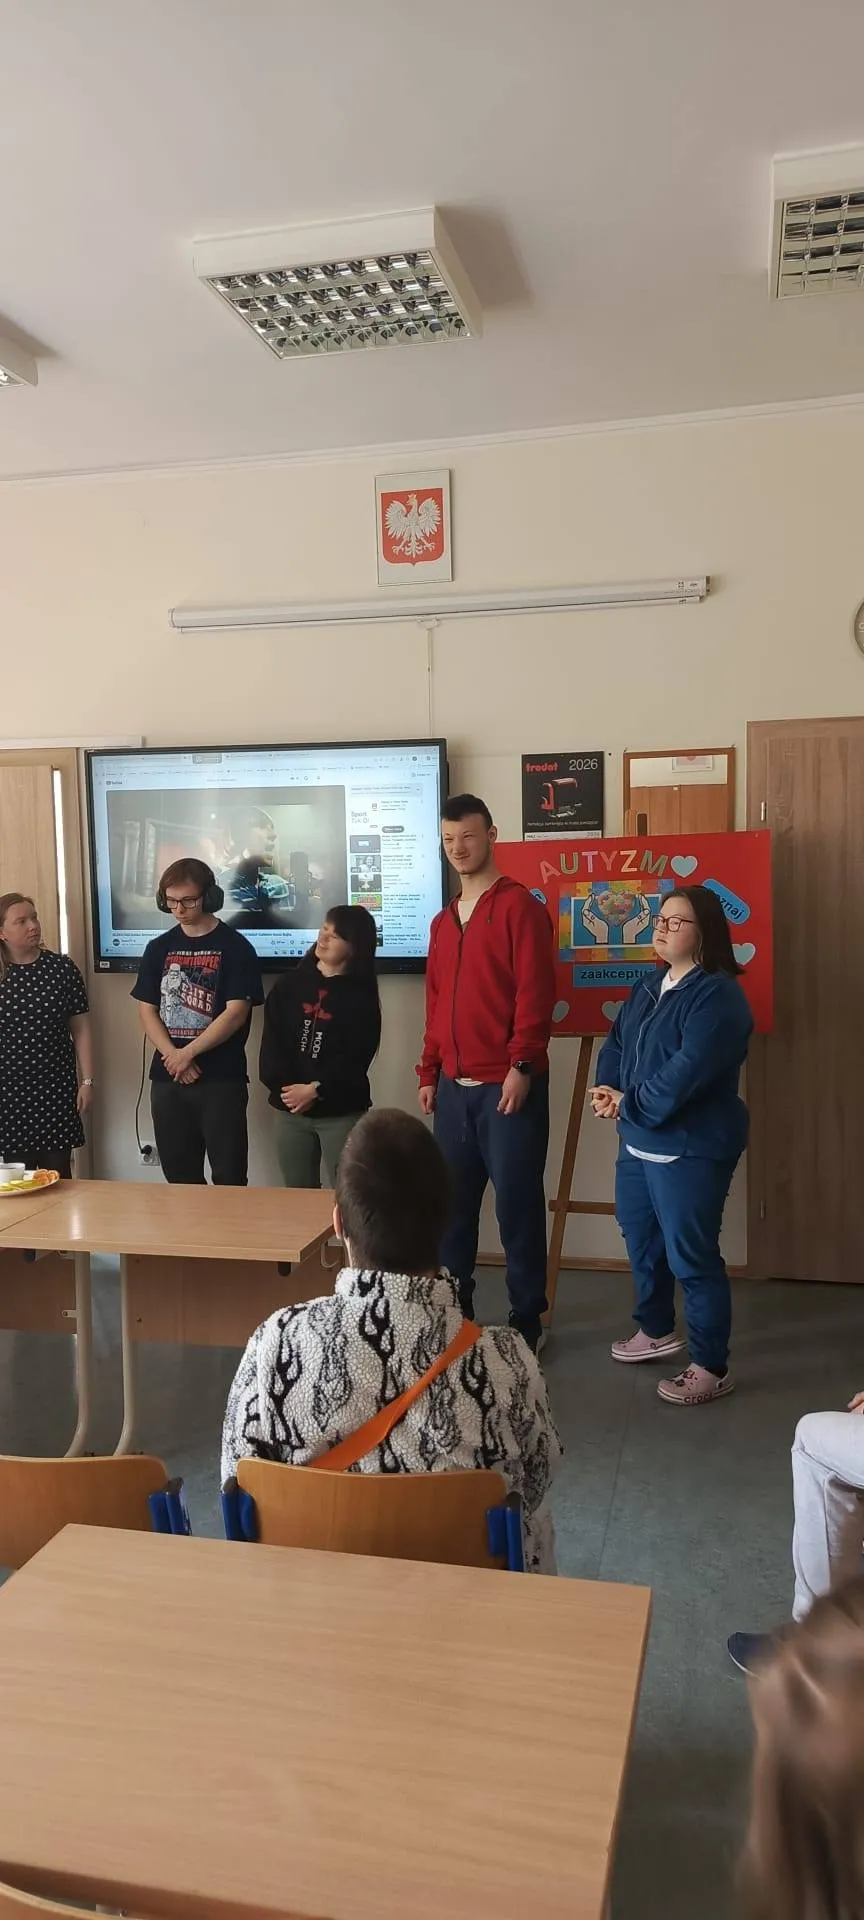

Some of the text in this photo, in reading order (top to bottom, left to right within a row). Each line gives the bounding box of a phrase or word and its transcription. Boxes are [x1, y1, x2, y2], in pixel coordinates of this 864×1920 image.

[569, 759, 598, 771] 2026
[540, 850, 668, 884] AUTYZM
[718, 895, 745, 920] znaj
[580, 968, 652, 981] zaakceptu
[181, 982, 212, 1003] ELITE
[181, 992, 212, 1012] SQUAD
